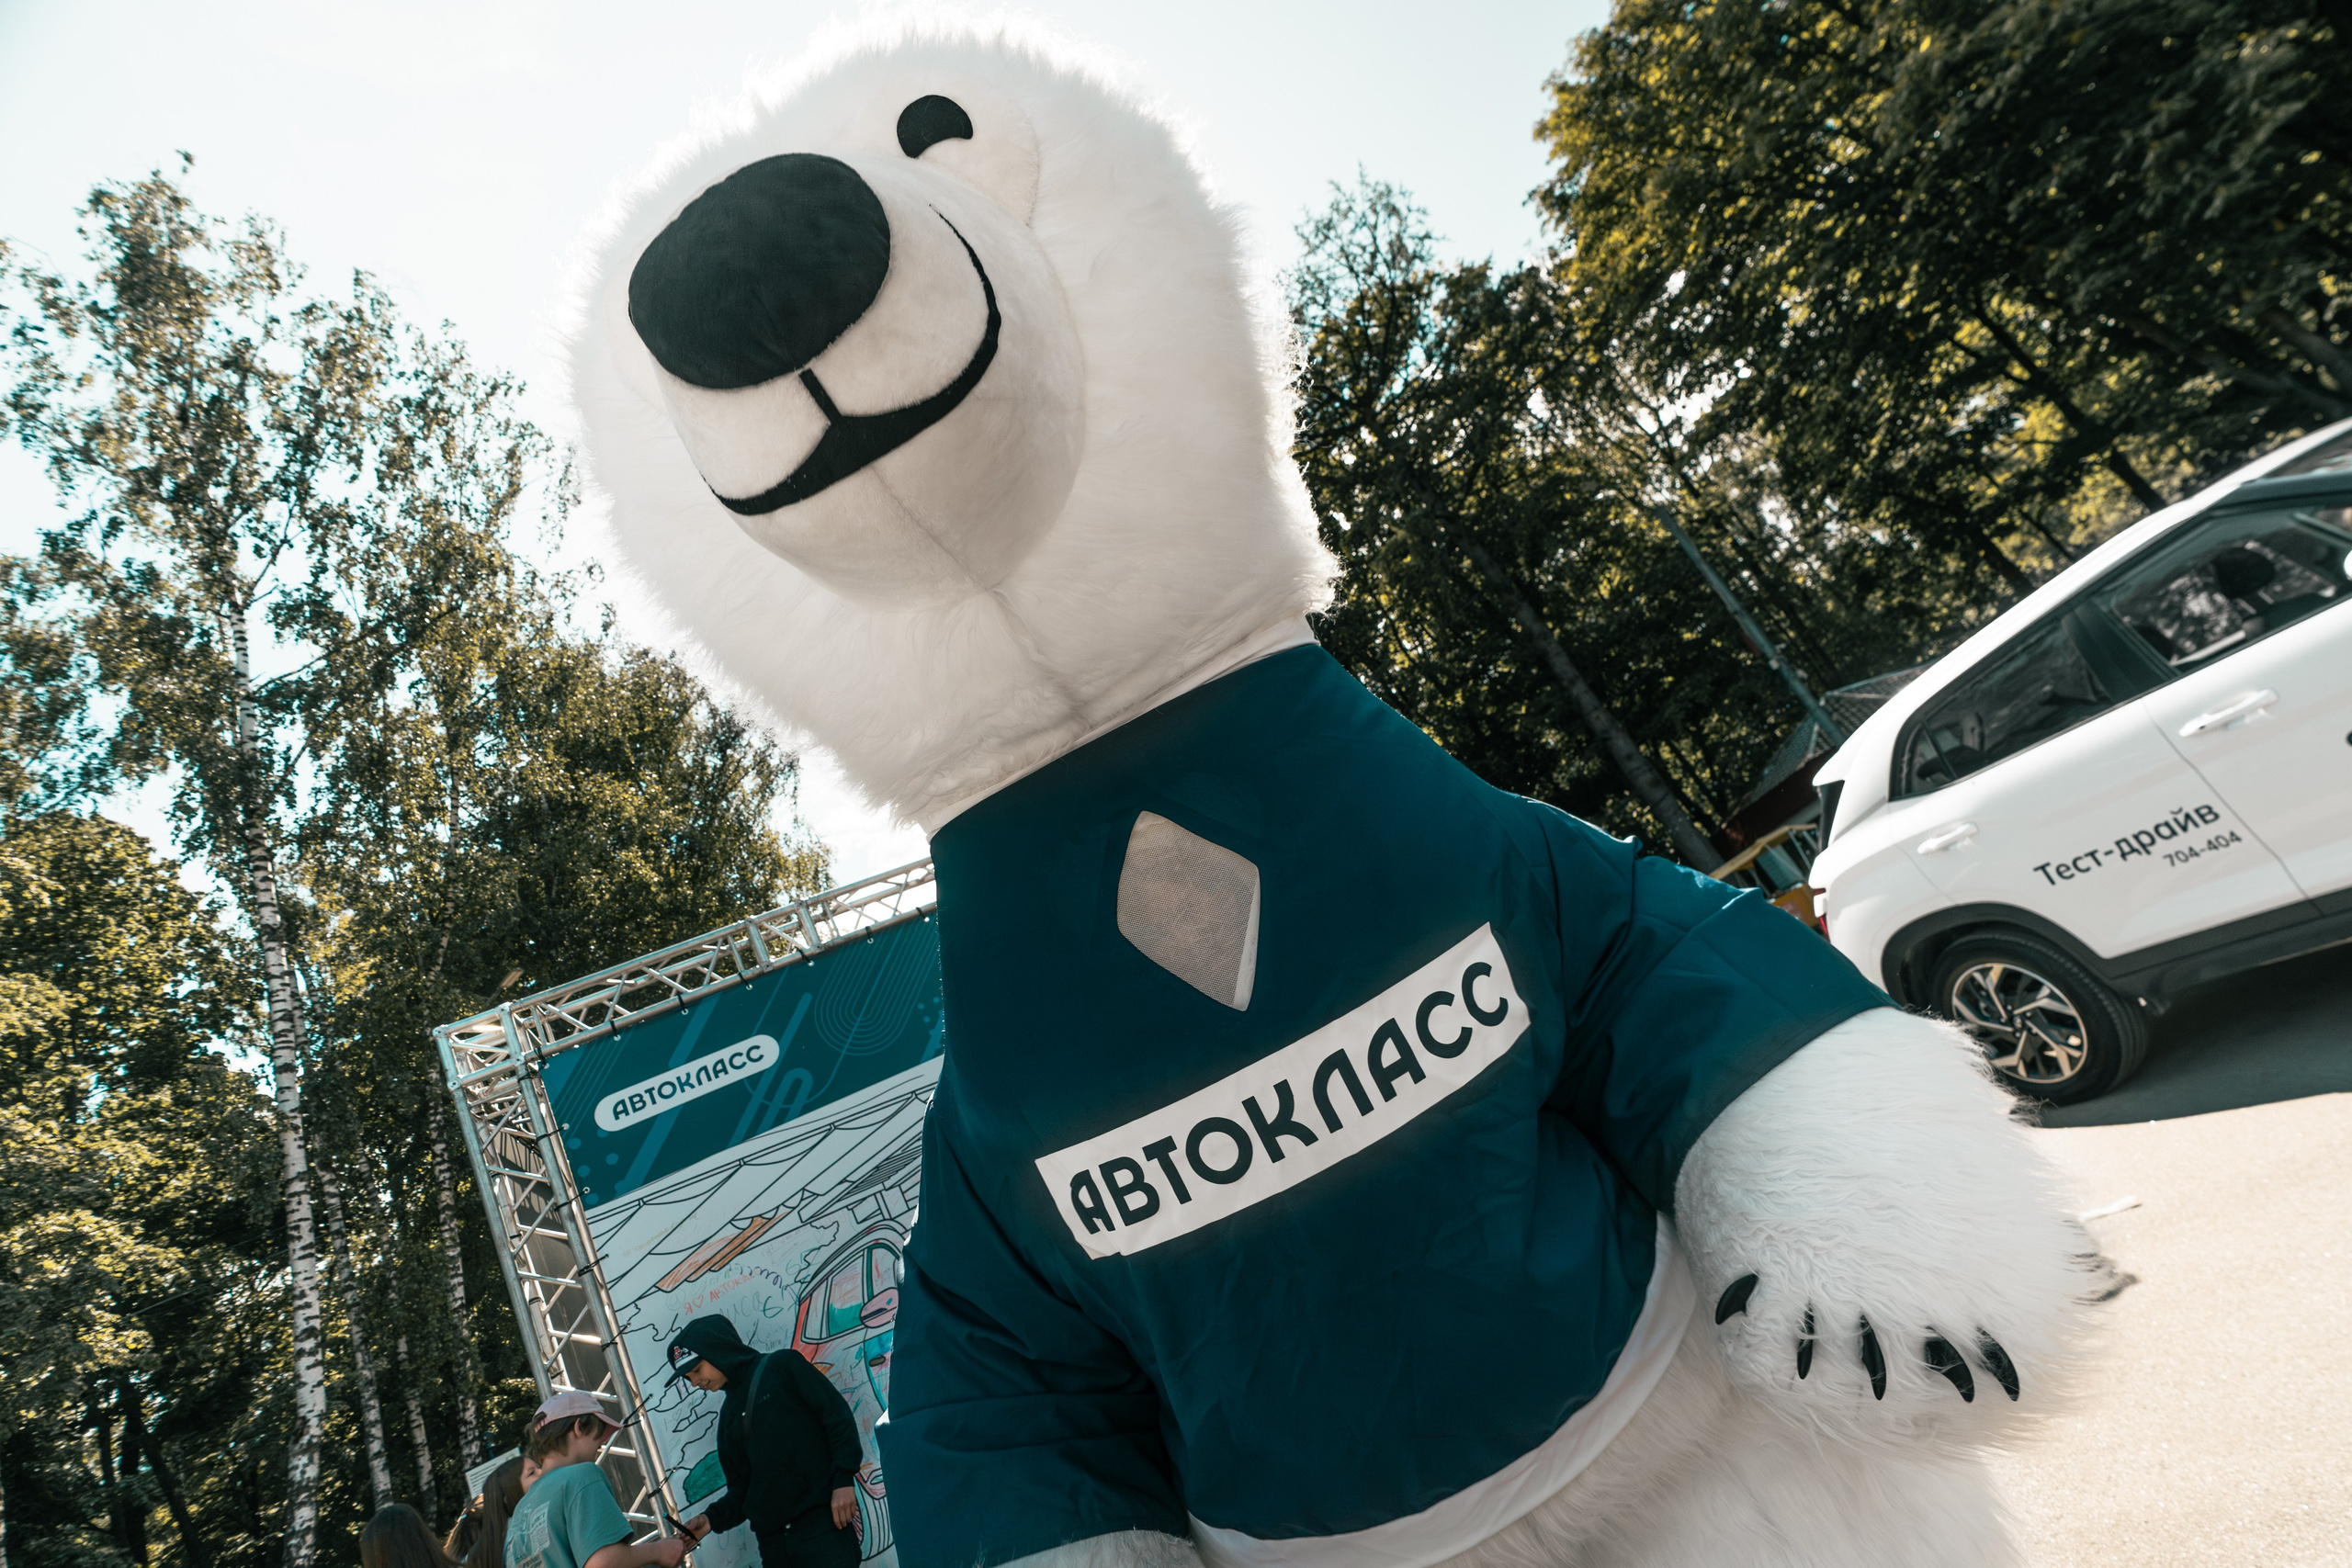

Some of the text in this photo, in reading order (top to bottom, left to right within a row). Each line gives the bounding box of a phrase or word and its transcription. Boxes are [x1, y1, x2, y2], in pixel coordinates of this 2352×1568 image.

[2033, 804, 2221, 886] Тест-драйв
[2162, 830, 2243, 867] 704-404
[612, 1044, 764, 1121] АВТОКЛАСС
[1069, 961, 1509, 1235] АВТОКЛАСС
